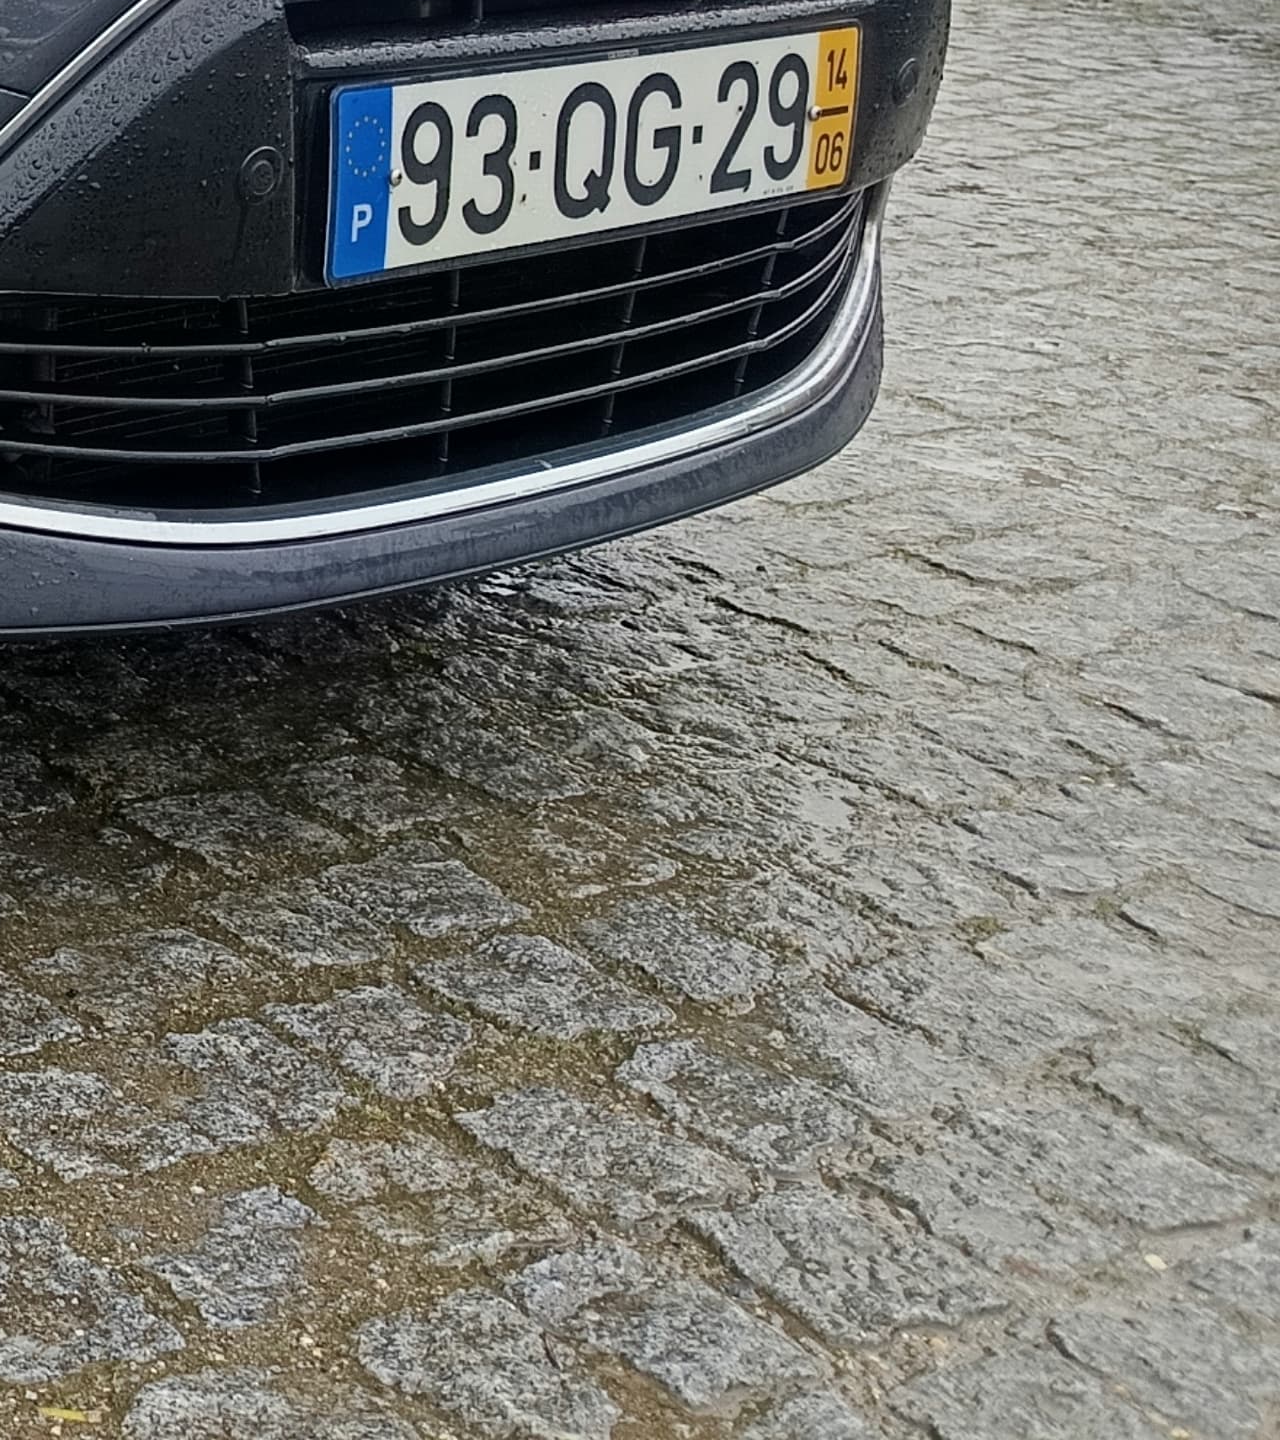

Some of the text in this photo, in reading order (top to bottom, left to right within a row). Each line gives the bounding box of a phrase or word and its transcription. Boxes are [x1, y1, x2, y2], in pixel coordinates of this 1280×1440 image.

[826, 48, 847, 92] 14
[815, 131, 844, 175] 06
[350, 204, 373, 242] P
